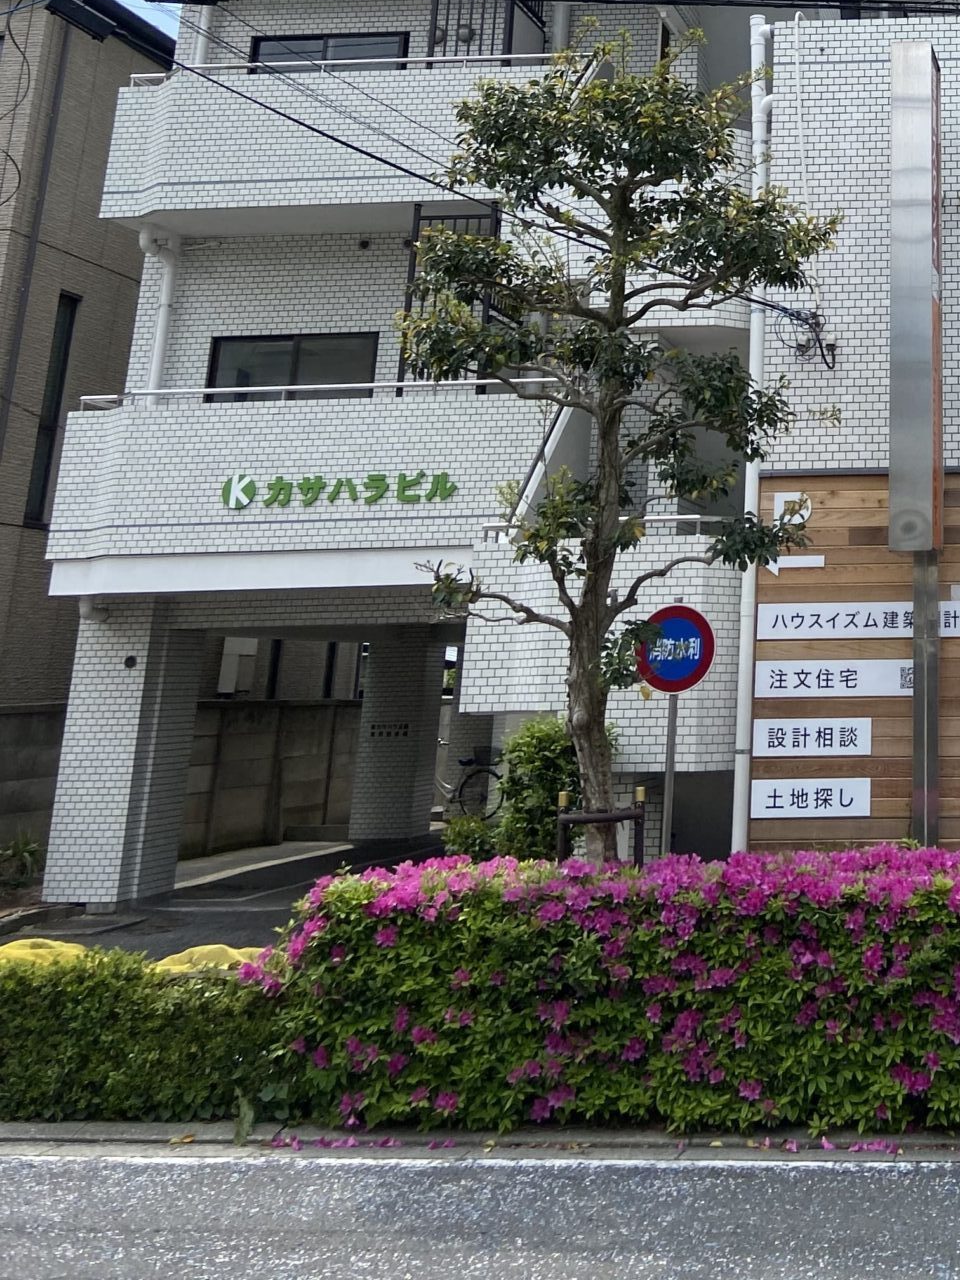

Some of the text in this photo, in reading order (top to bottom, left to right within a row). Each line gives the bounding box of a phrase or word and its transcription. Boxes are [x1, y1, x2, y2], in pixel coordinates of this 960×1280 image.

[226, 469, 458, 509] K カサハラビル
[773, 491, 812, 533] P
[768, 668, 859, 690] 注文住宅
[767, 726, 859, 749] 設計相談
[765, 787, 854, 810] 土地探し
